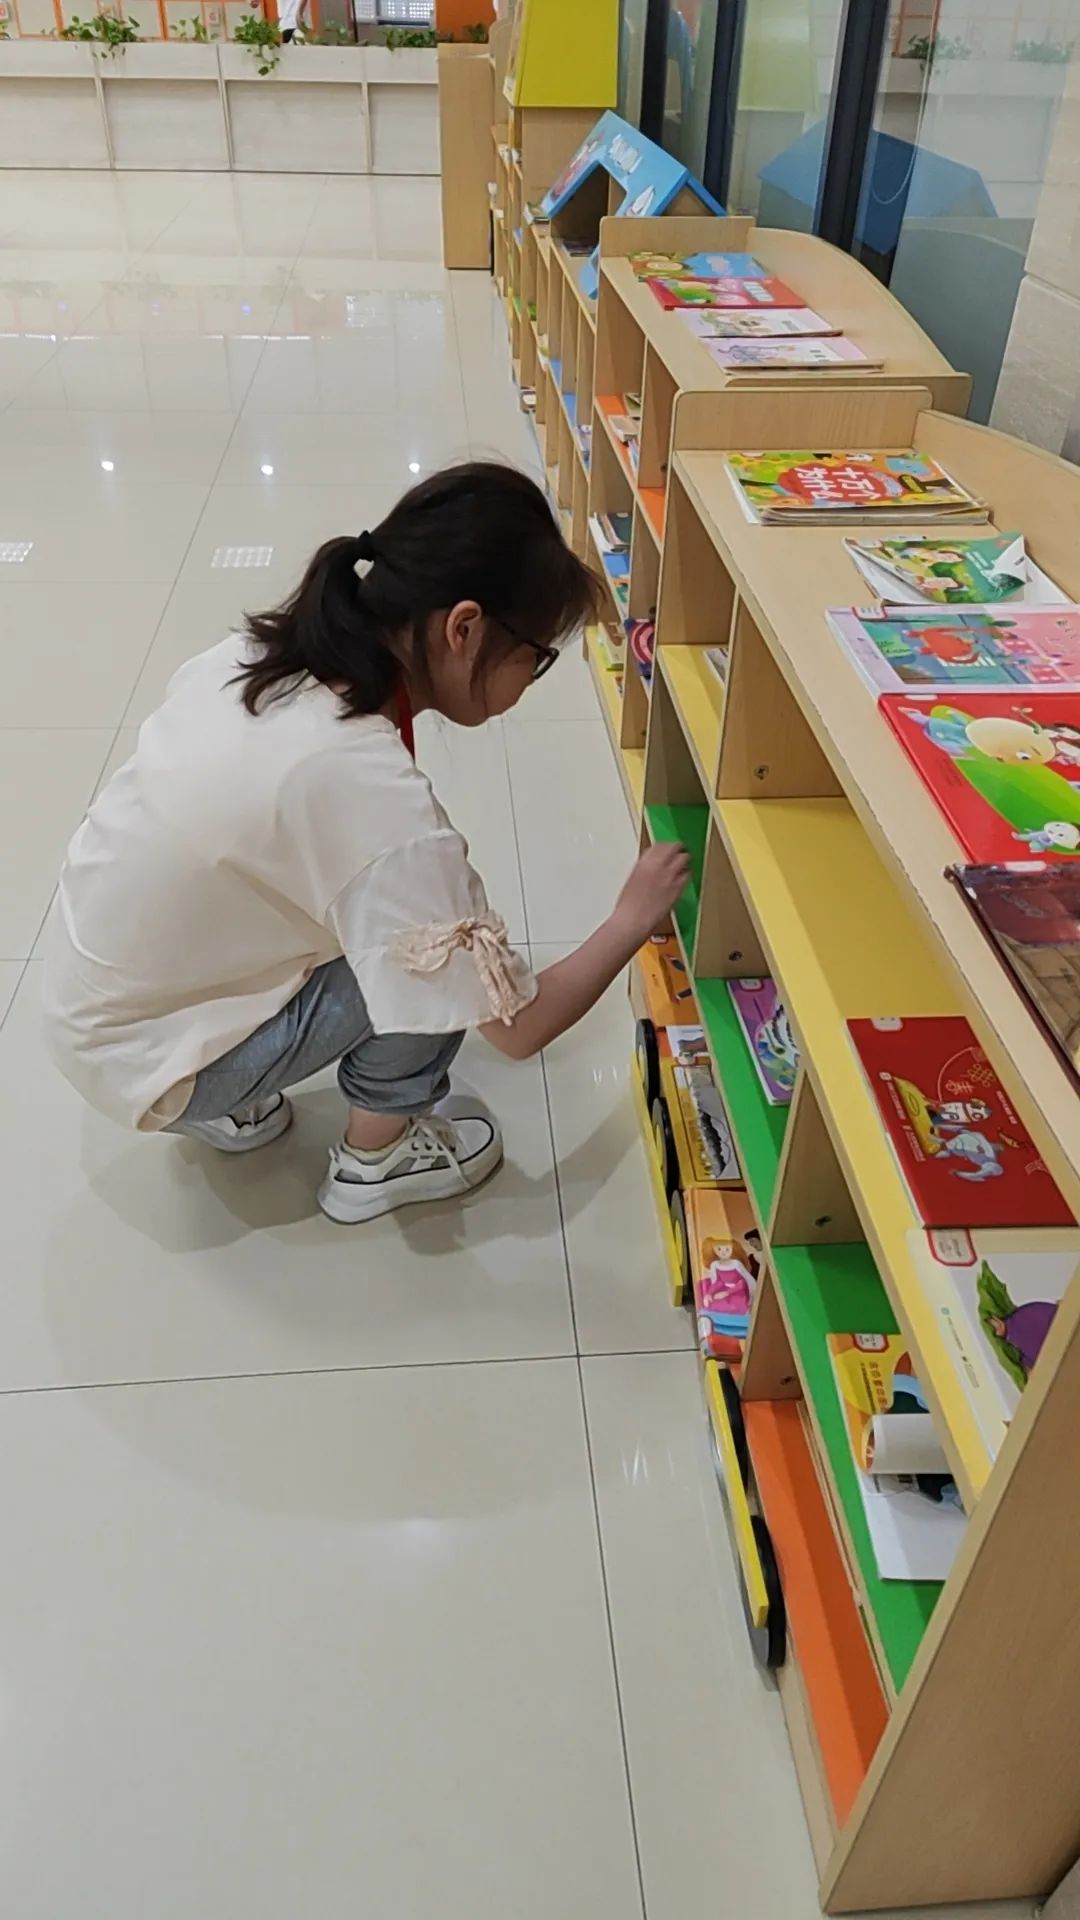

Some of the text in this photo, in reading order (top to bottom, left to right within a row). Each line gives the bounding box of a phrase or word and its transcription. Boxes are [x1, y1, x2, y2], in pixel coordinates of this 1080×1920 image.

[794, 467, 843, 499] 为什么
[831, 467, 882, 500] 十万个
